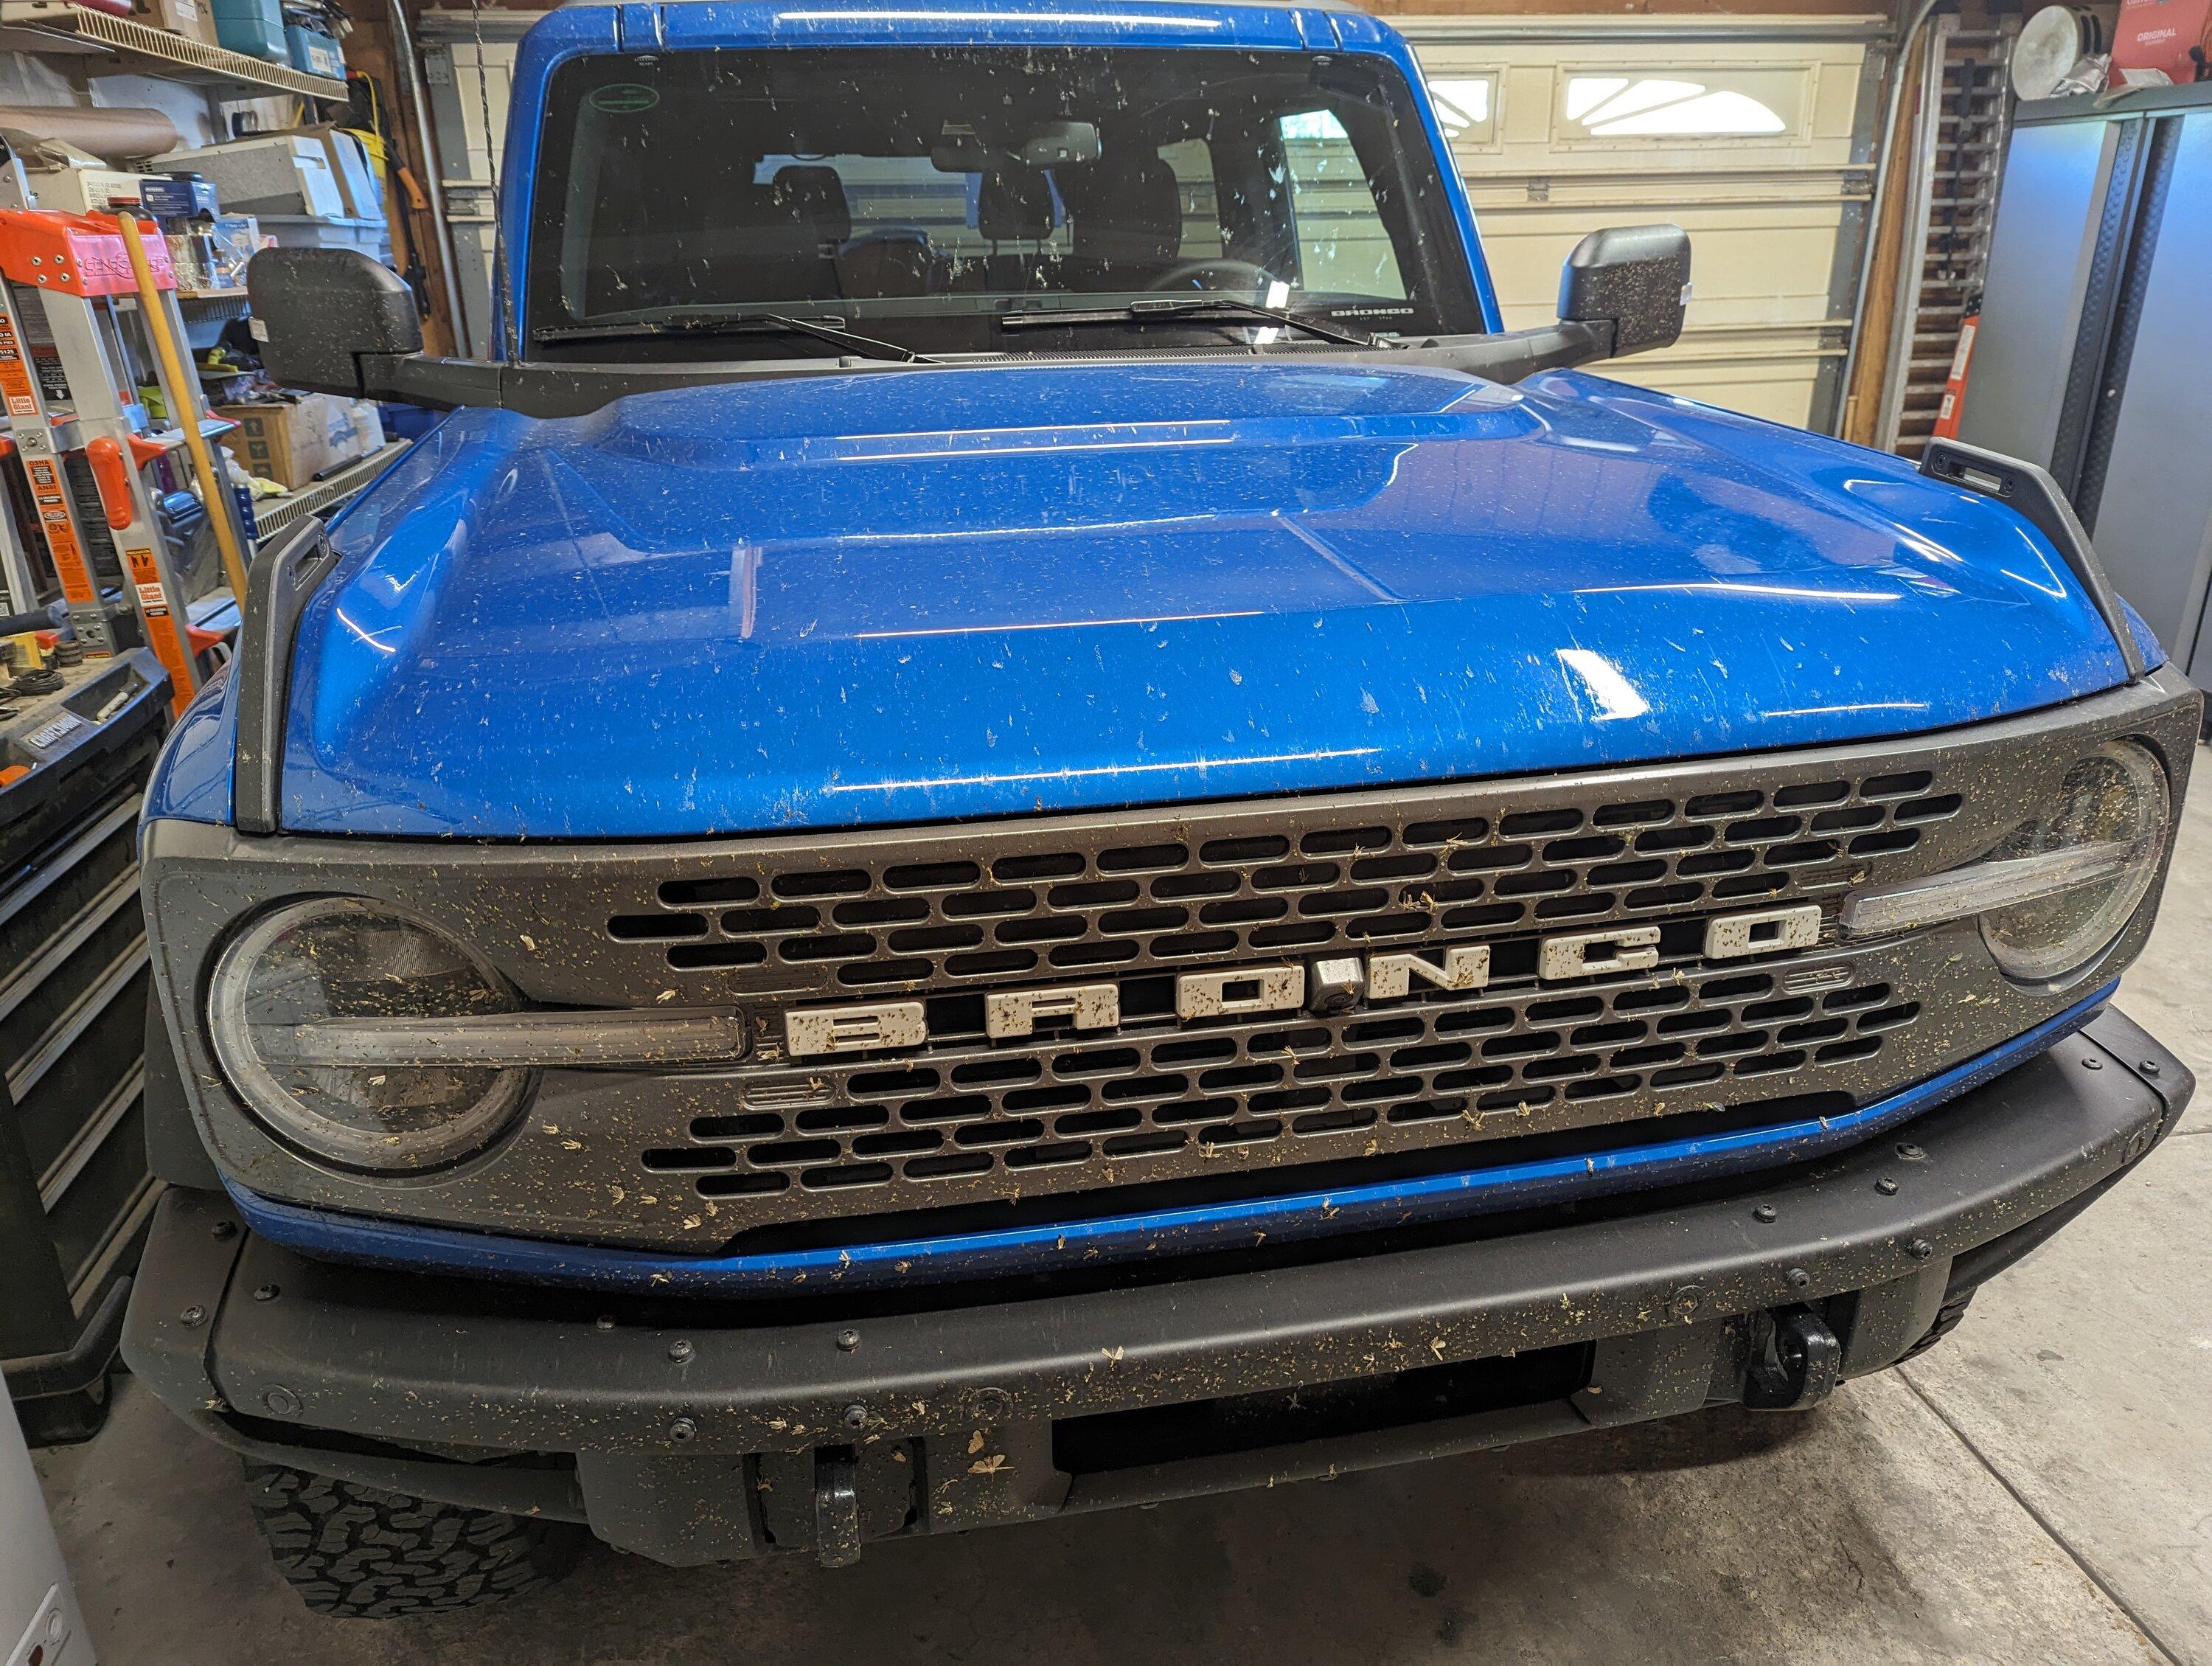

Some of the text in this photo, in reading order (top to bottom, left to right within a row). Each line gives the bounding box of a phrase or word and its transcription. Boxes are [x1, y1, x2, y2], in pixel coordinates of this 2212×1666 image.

[2137, 27, 2177, 42] ORIGINAL
[1331, 308, 1414, 316] BRONCO
[30, 715, 82, 749] CRAFTSMAN
[785, 905, 1822, 1057] BRONCO
